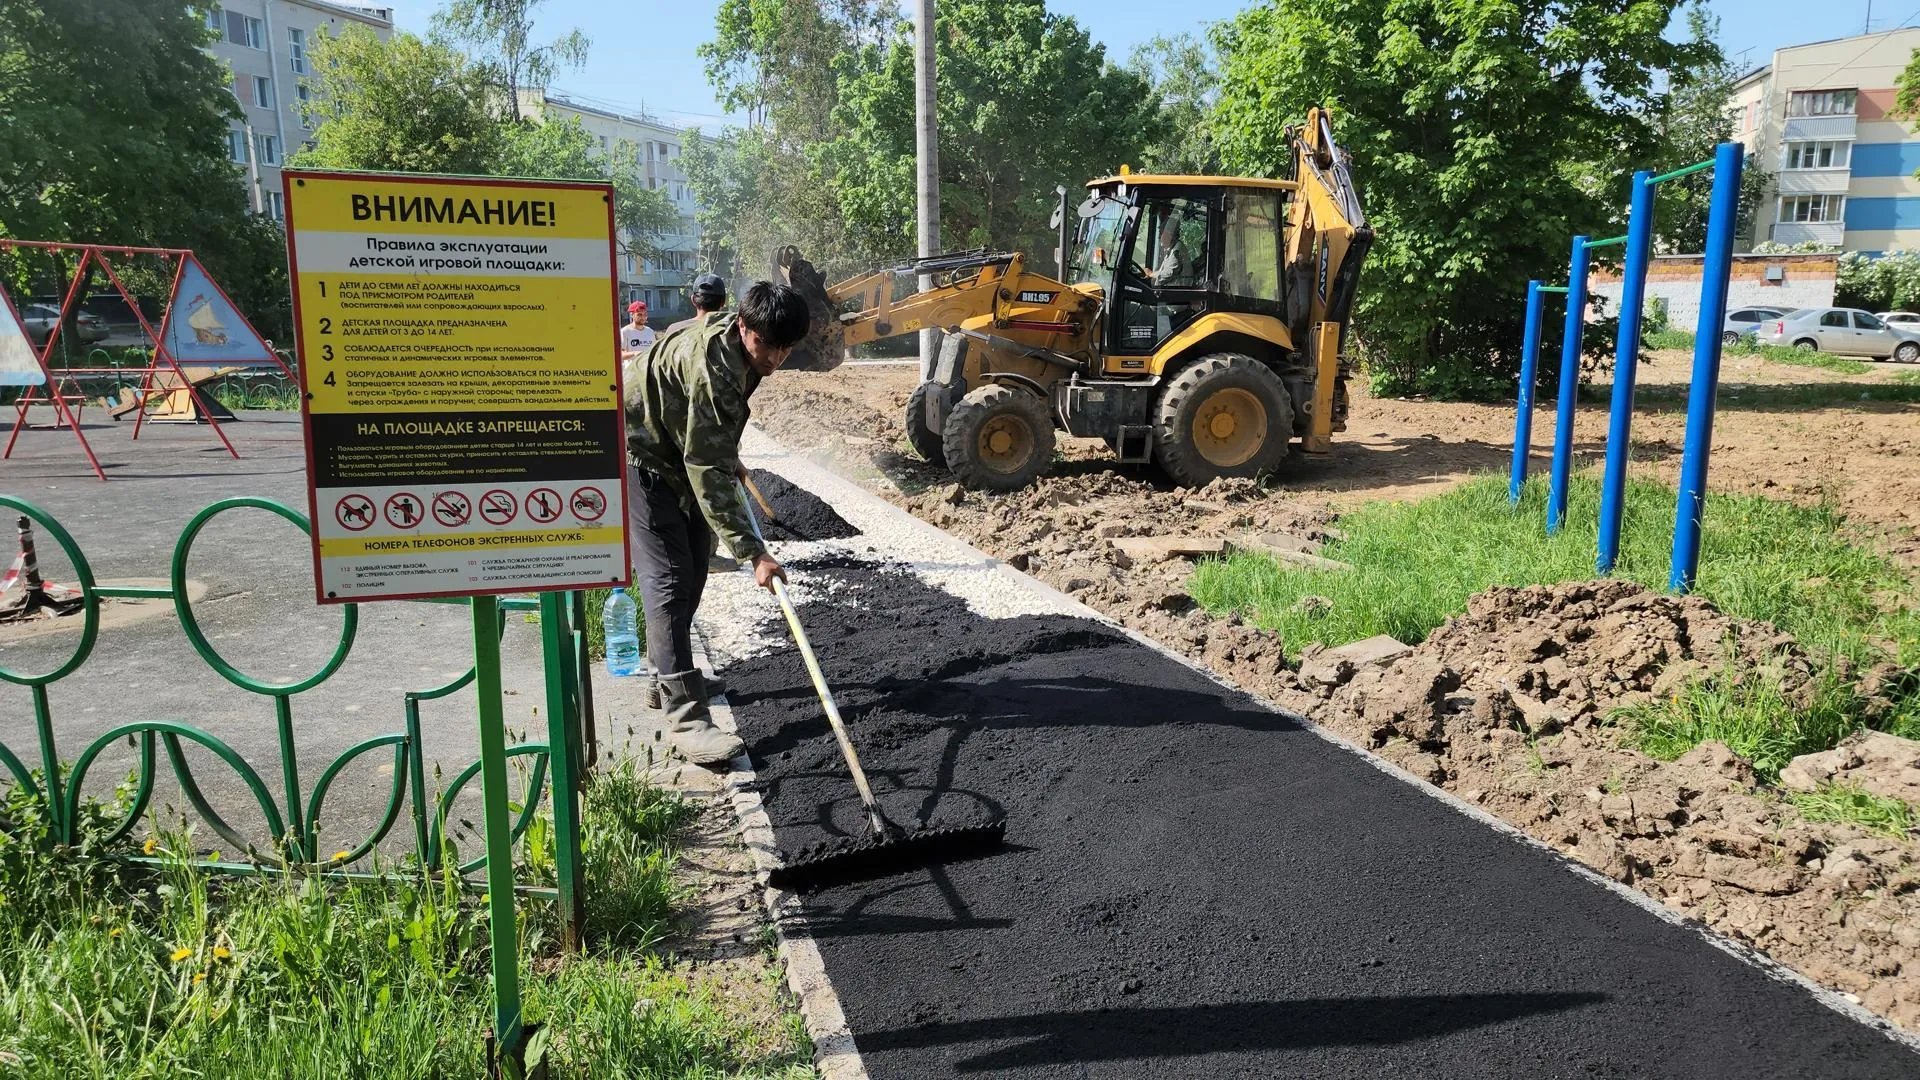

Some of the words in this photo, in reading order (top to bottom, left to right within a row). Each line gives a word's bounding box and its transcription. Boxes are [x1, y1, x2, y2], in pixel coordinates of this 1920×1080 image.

[351, 194, 556, 227] ВНИМАНИЕ!
[366, 238, 435, 252] Правила
[440, 242, 548, 255] эксплуатации
[349, 255, 415, 268] детской
[420, 257, 482, 271] игровой
[487, 260, 566, 272] площадки:
[318, 282, 326, 298] 1
[339, 281, 361, 289] ДЕТИ
[363, 282, 377, 290] ДО
[363, 292, 424, 300] ПРИСМОТРОМ
[426, 293, 474, 301] РОДИТЕЛЕЙ
[424, 303, 501, 311] сопровождающих
[319, 318, 331, 335] 2
[437, 320, 508, 328] ПРЕДНАЗНАЧЕНА
[363, 328, 388, 336] ДЕТЕЙ
[322, 345, 334, 361] 3
[344, 345, 411, 353] СОБЛЮДАЕТСЯ
[413, 345, 474, 353] ОЧЕРЕДНОСТЬ
[324, 371, 336, 387] 4
[347, 380, 406, 388] Запрещается
[358, 424, 379, 435] НА
[384, 422, 473, 435] ПЛОЩАДКЕ
[478, 420, 585, 434] ЗАПРЕЩАЕТСЯ:
[364, 540, 410, 550] НОМЕРА
[412, 537, 475, 548] ТЕЛЕФОНОВ
[478, 535, 545, 546] ЭКСТРЕННЫХ
[546, 532, 585, 543] СЛУЖБ:
